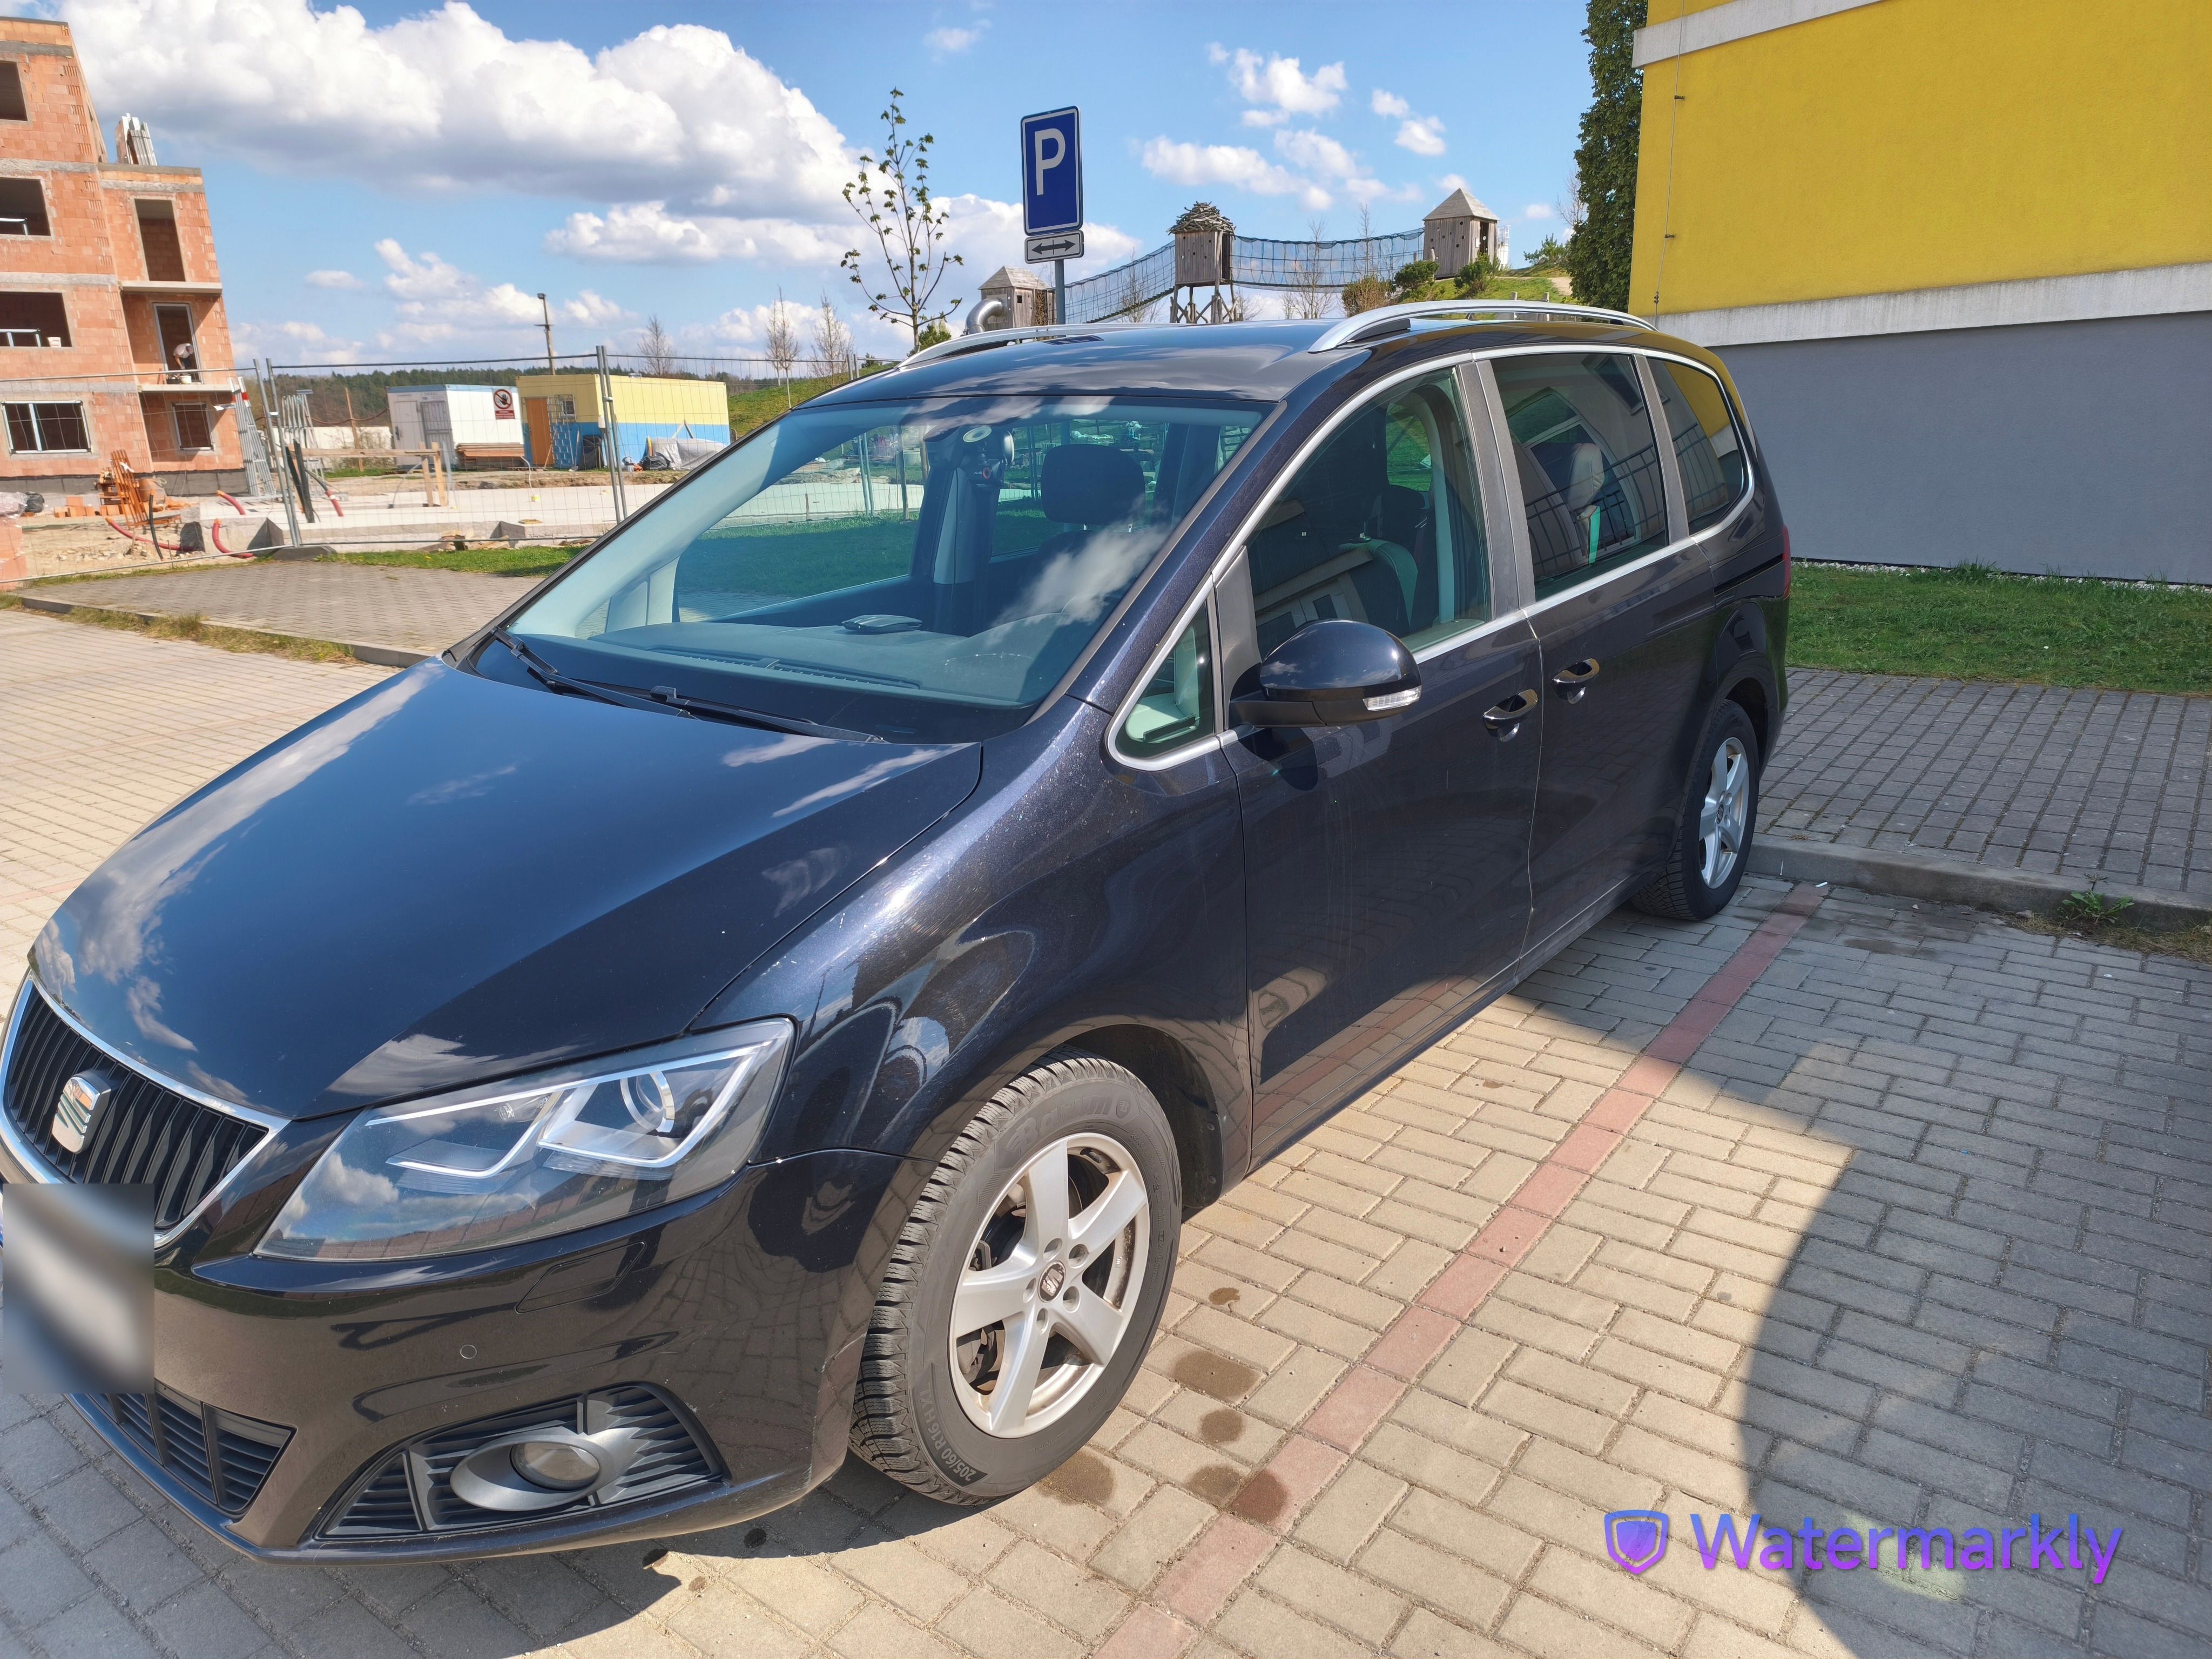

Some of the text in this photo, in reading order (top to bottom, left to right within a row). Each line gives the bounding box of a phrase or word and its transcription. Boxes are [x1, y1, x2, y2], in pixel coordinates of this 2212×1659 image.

[1035, 128, 1065, 195] P
[1006, 1096, 1113, 1155] Barum
[920, 1382, 977, 1481] 205/60 R16 H XL
